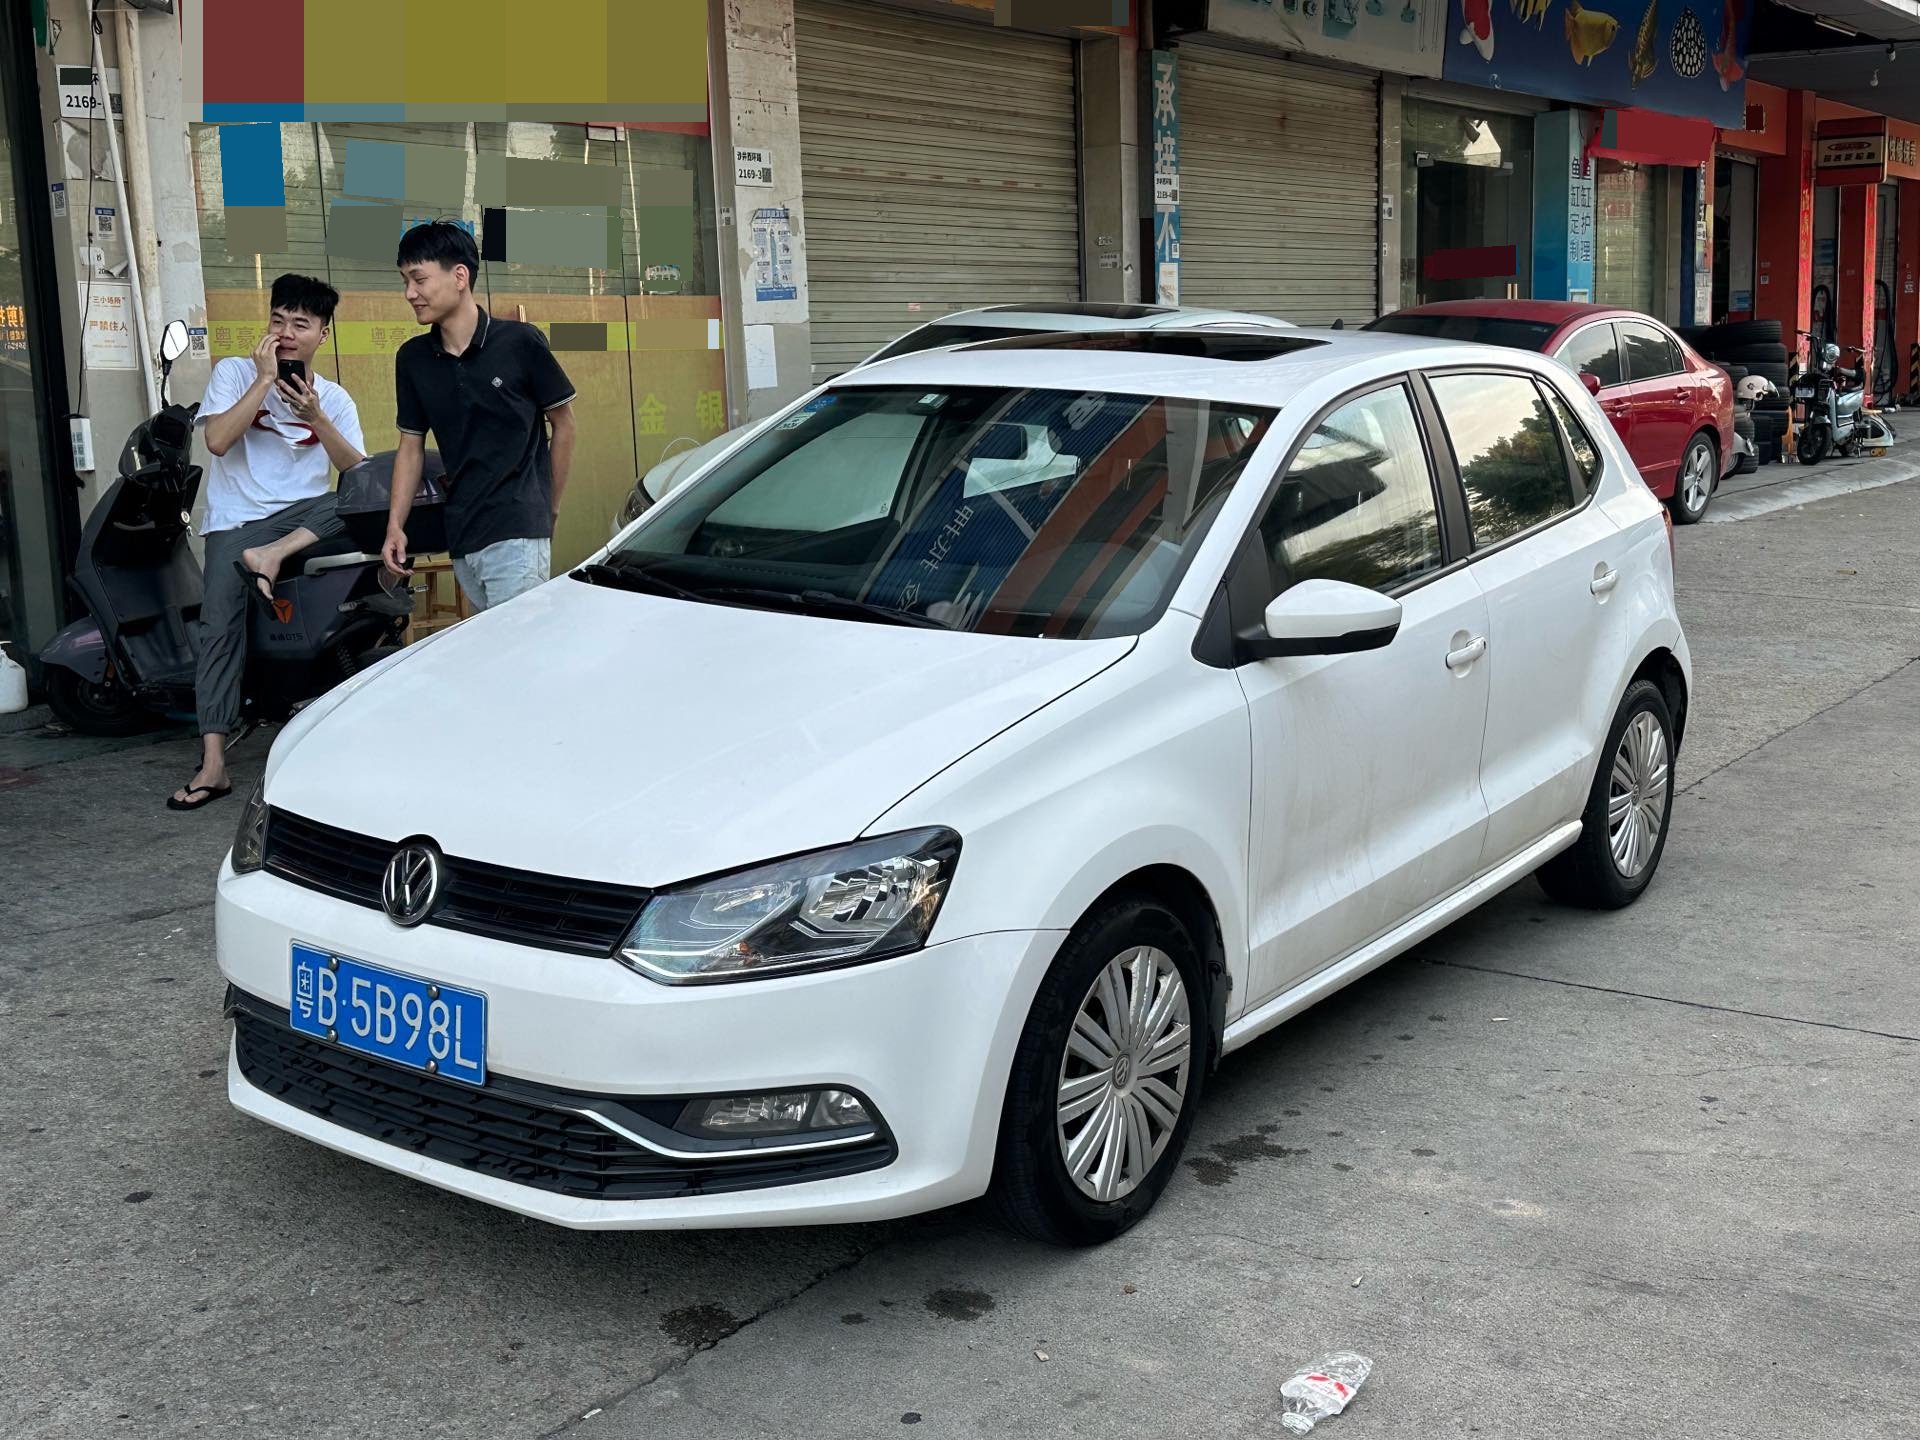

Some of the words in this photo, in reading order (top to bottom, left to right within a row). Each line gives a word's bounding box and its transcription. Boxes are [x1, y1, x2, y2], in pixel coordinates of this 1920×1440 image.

[738, 168, 762, 179] 2169-3
[1570, 156, 1581, 262] 鱼缸定制
[213, 325, 268, 351] 粤豪
